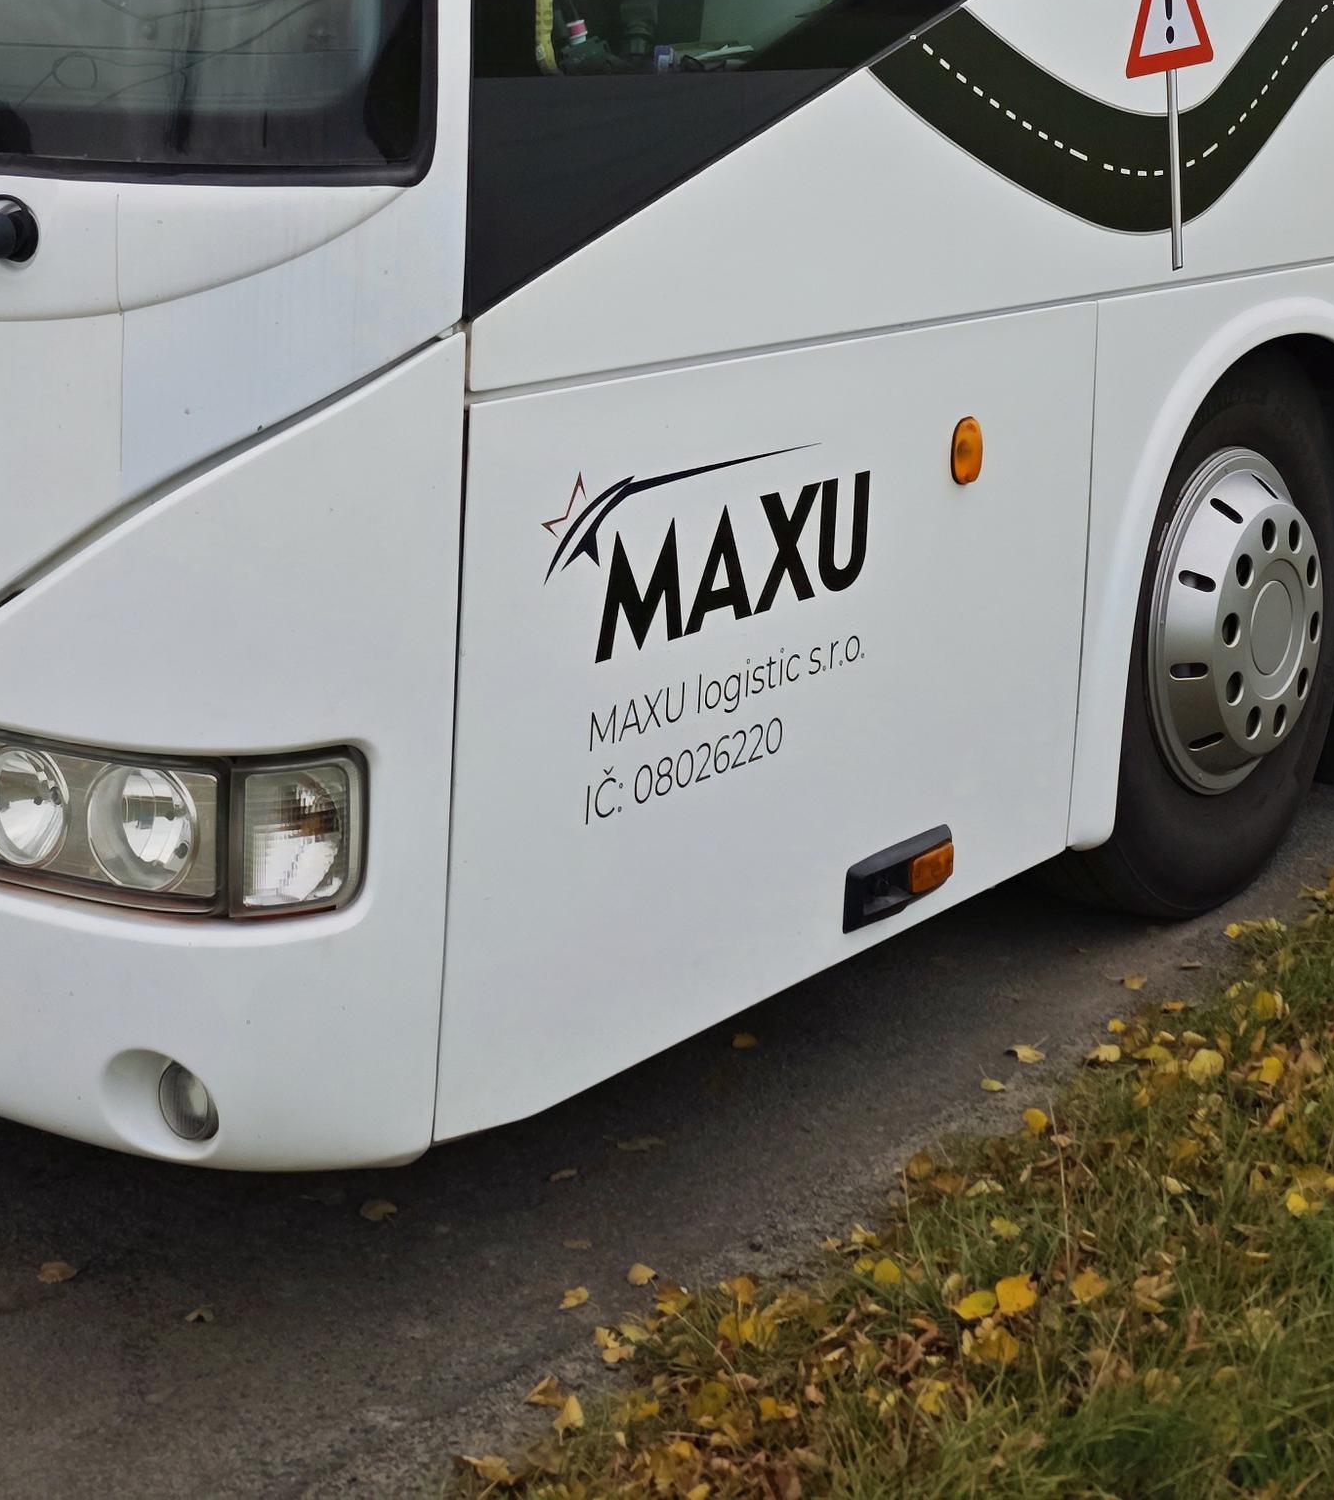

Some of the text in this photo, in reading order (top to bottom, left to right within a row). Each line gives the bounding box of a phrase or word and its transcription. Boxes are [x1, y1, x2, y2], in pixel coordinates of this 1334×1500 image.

[595, 470, 871, 664] MAXU
[589, 635, 866, 752] MAXU logistic s.r.o.
[585, 717, 783, 825] IČ: 08026220
